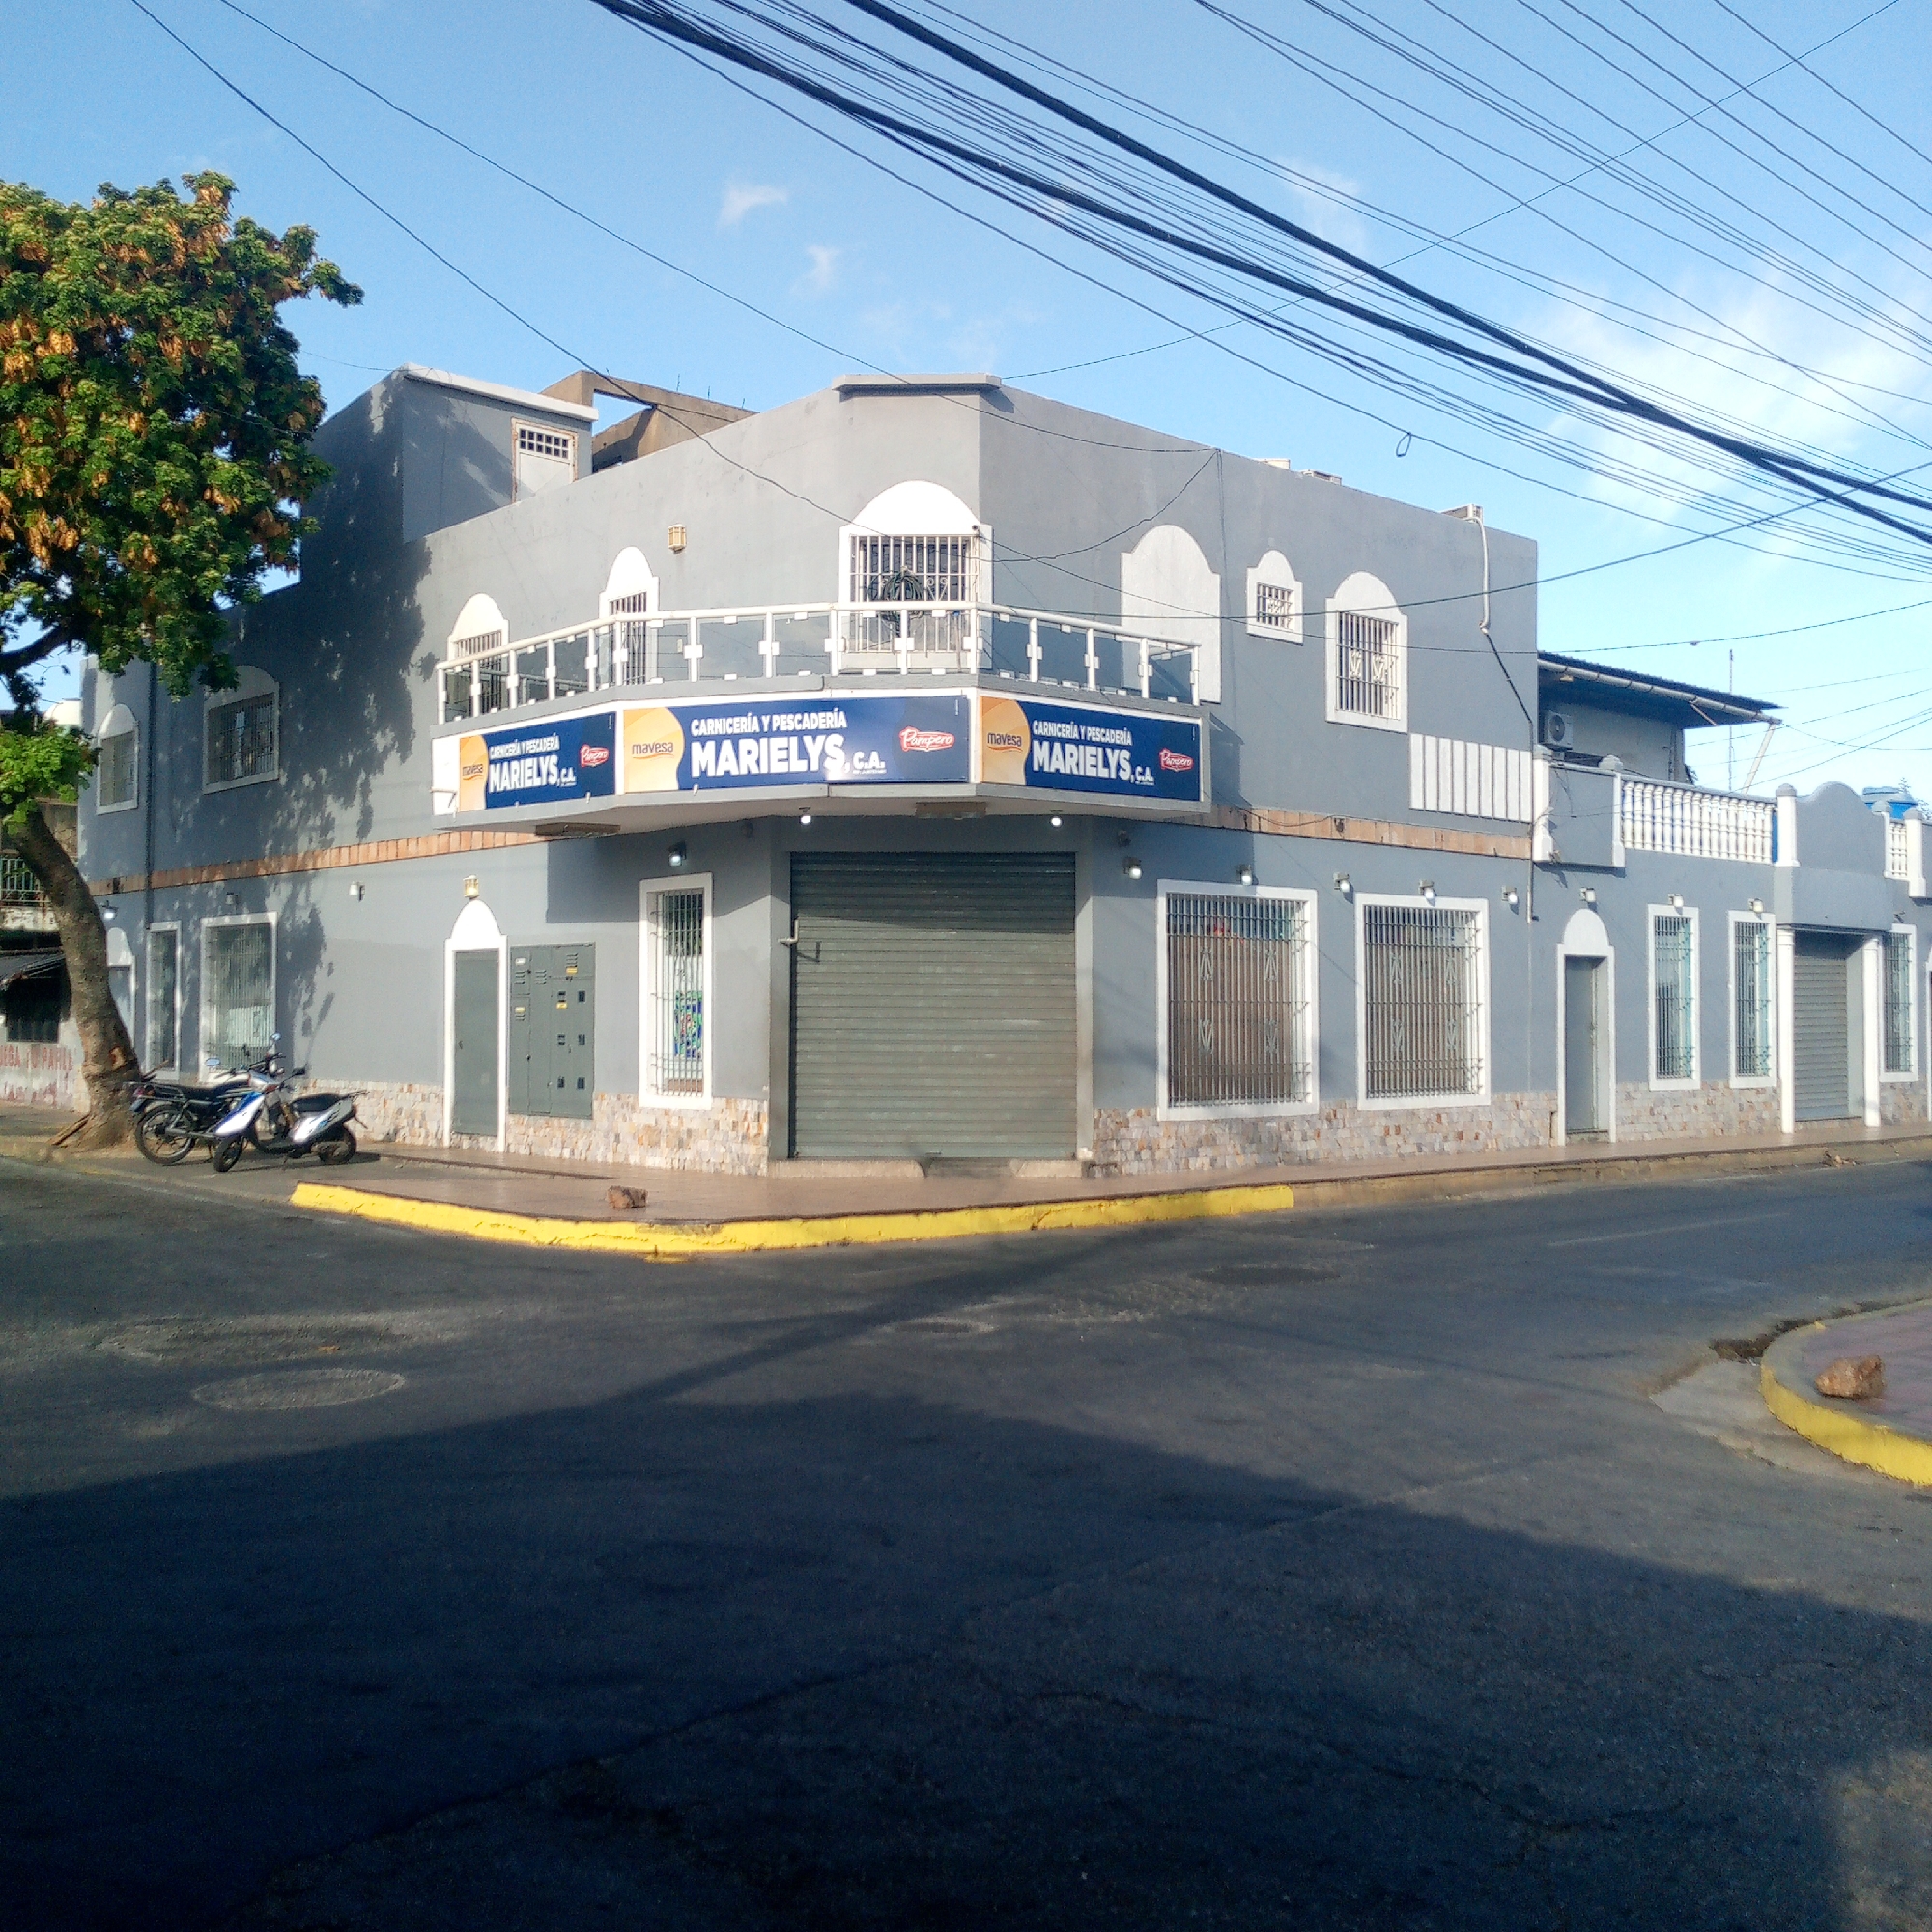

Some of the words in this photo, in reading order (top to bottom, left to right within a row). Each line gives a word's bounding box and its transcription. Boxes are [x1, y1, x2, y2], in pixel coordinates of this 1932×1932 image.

[691, 713, 760, 737] CARNICERÍA
[760, 715, 772, 733] Y
[772, 708, 847, 731] PESCADERÍA
[986, 732, 1022, 748] mavesa
[1032, 719, 1079, 739] CARNICERÍA
[1080, 725, 1087, 741] Y
[1087, 726, 1133, 746] PESCADERÍA
[521, 741, 526, 754] Y
[632, 741, 674, 755] mavesa
[852, 751, 887, 770] C.A.
[1135, 765, 1155, 782] C.A.
